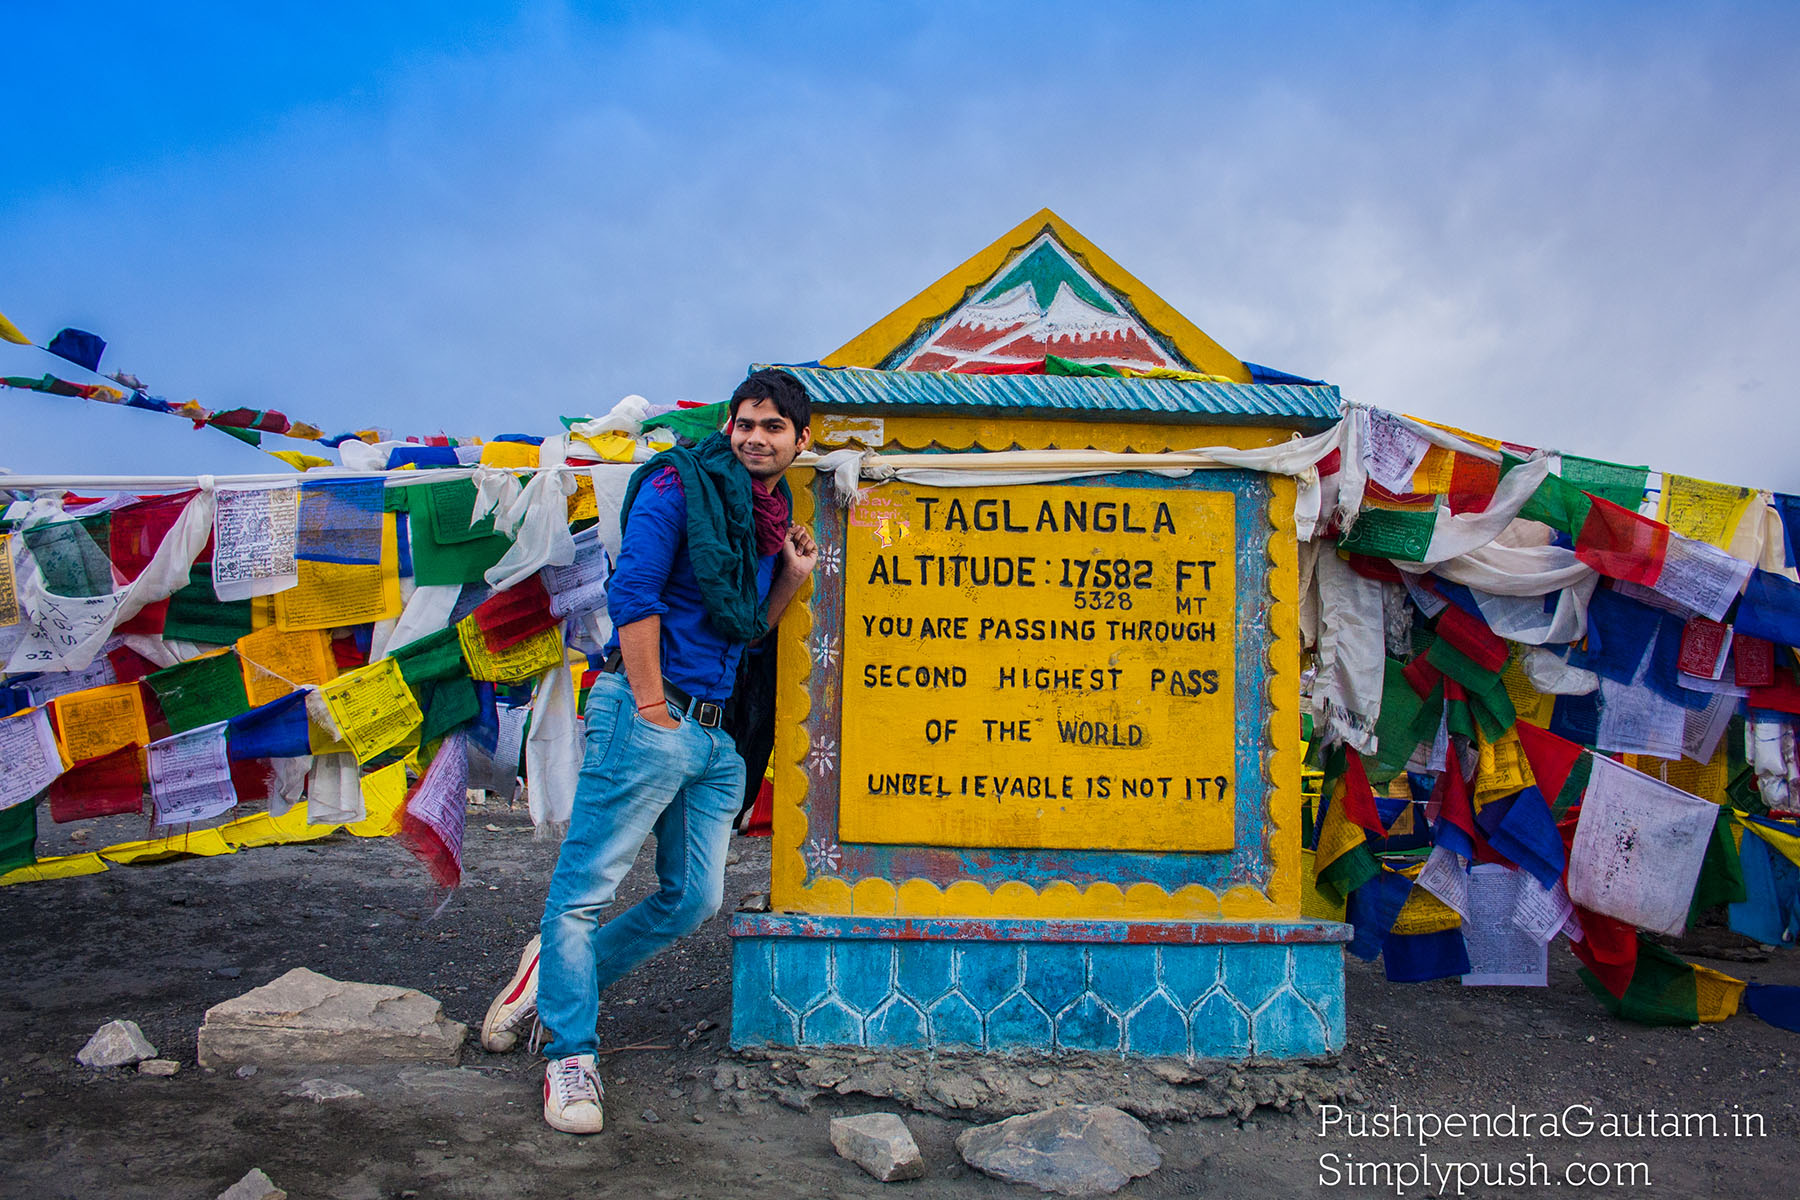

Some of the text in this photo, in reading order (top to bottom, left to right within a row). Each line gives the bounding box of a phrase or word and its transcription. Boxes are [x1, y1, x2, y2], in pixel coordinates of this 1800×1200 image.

[915, 497, 1177, 535] TAGLANGLA
[1059, 558, 1154, 590] 17582
[1175, 559, 1218, 593] FT
[1073, 590, 1208, 616] 5328 MT
[861, 614, 1217, 643] YOU ARE PASSING THROUGH
[863, 664, 1220, 698] SECOND HIGHEST PASS
[925, 718, 1144, 748] OF THE WORLD
[866, 772, 1230, 804] UNBELIEVABLE IS NOT IT?
